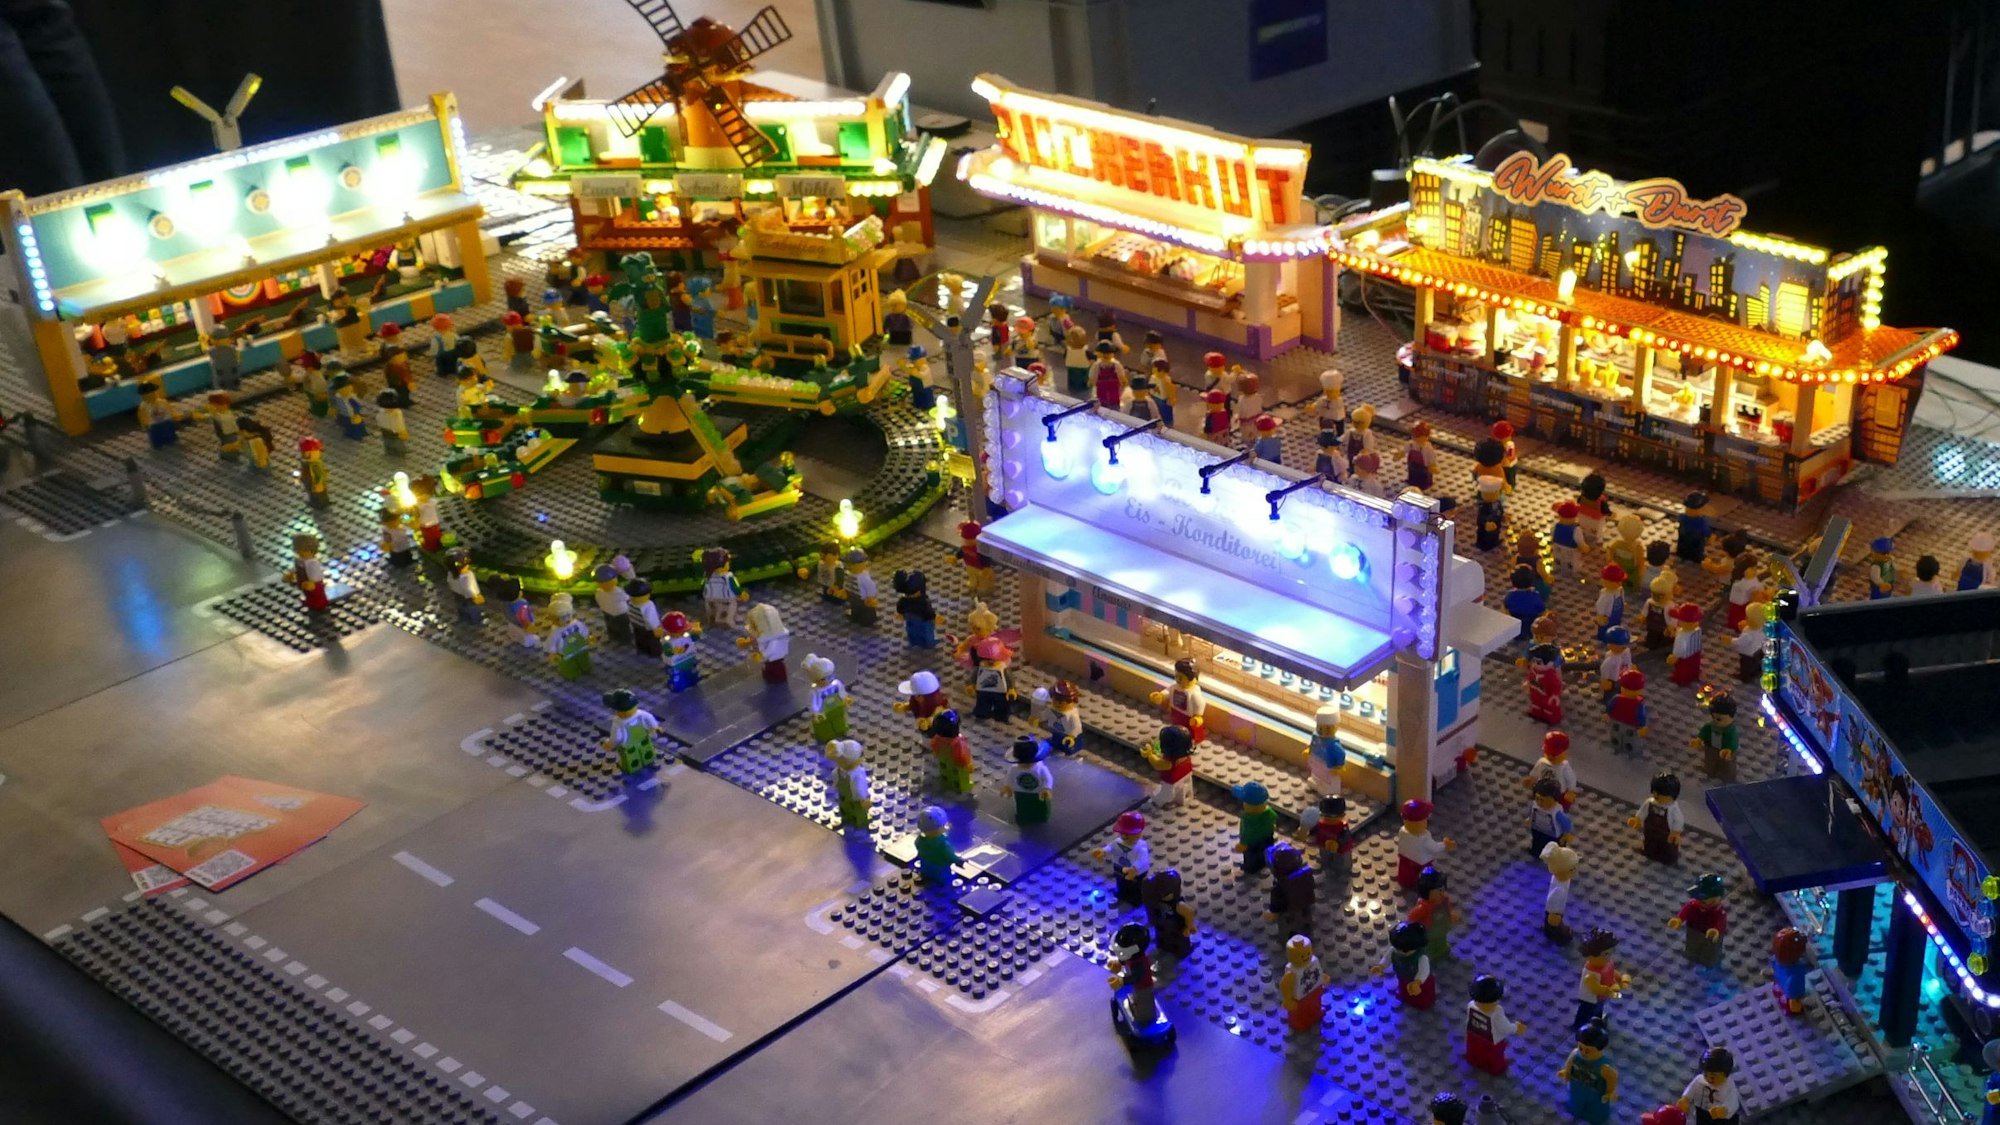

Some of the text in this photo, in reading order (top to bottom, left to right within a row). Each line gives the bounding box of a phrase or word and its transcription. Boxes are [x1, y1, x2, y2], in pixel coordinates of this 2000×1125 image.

[1495, 157, 1608, 208] Wurst
[1626, 185, 1742, 232] Durst
[1125, 497, 1150, 524] Eis
[1172, 514, 1277, 570] Konditorei
